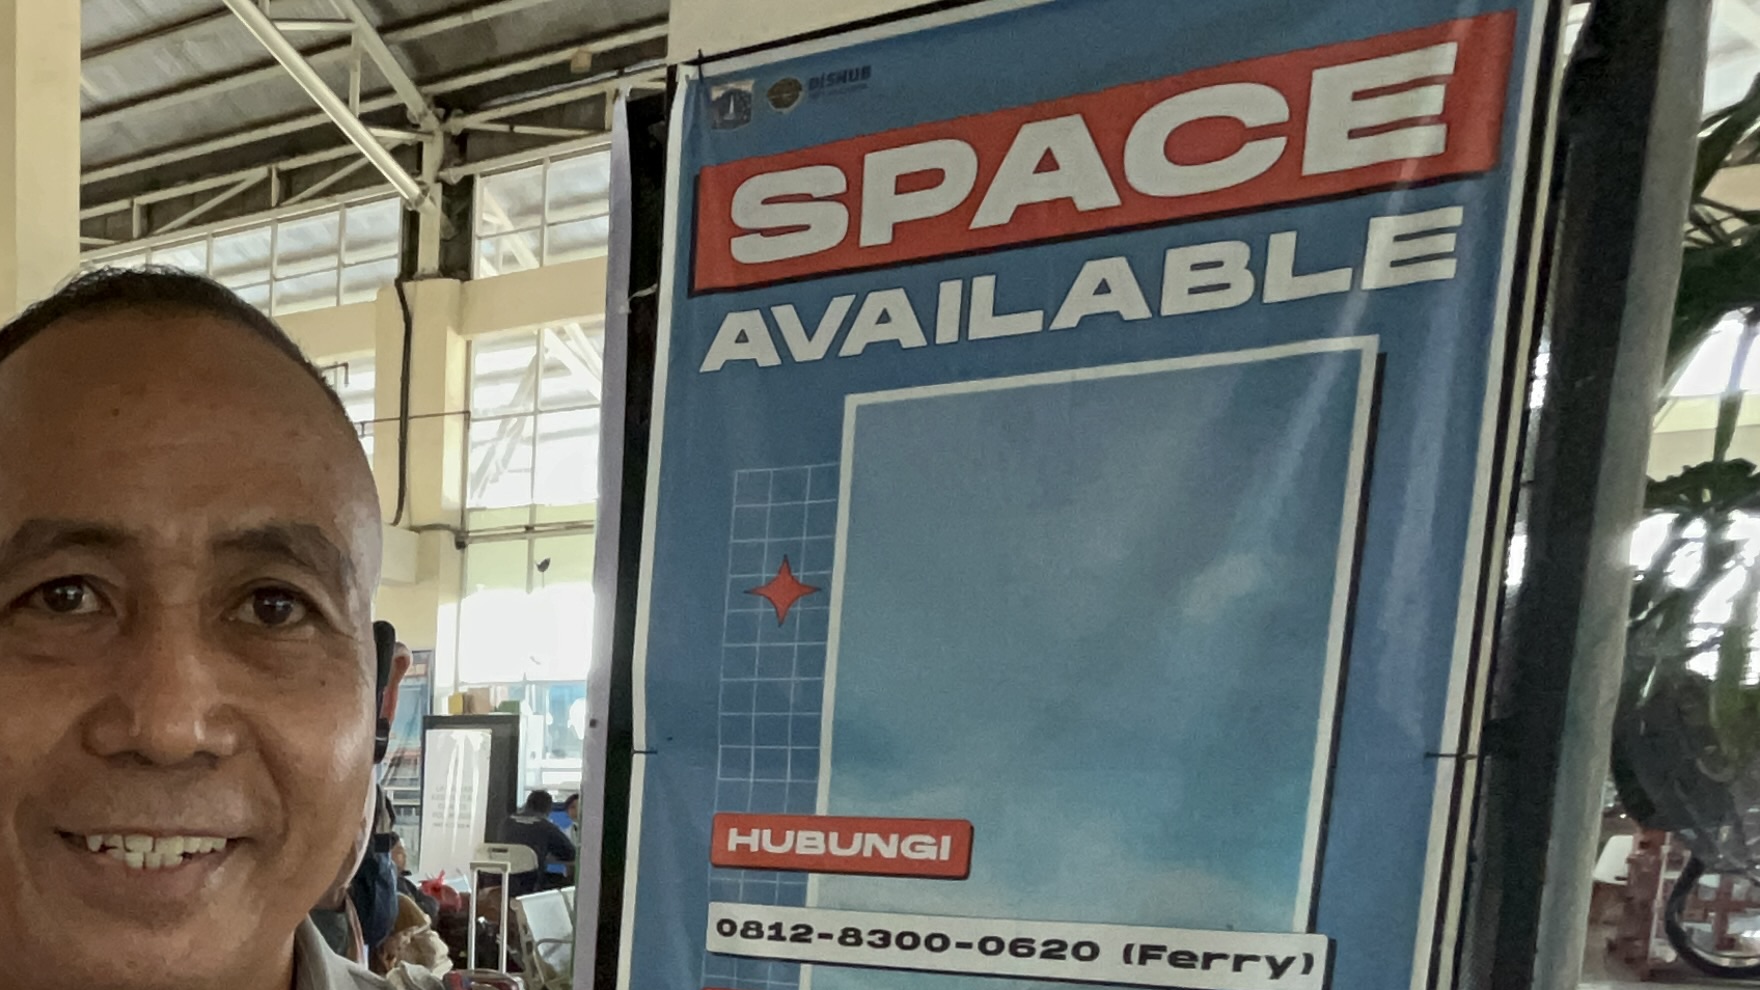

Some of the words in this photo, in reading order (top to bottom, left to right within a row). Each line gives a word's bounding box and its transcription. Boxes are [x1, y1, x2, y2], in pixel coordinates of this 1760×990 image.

[808, 65, 872, 91] DISHUB
[730, 42, 1459, 266] SPACE
[699, 206, 1463, 373] AVAILABLE
[727, 827, 951, 861] HUBUNGI
[716, 918, 1101, 962] 0812-8300-0620
[1123, 943, 1314, 980] (Ferry)
